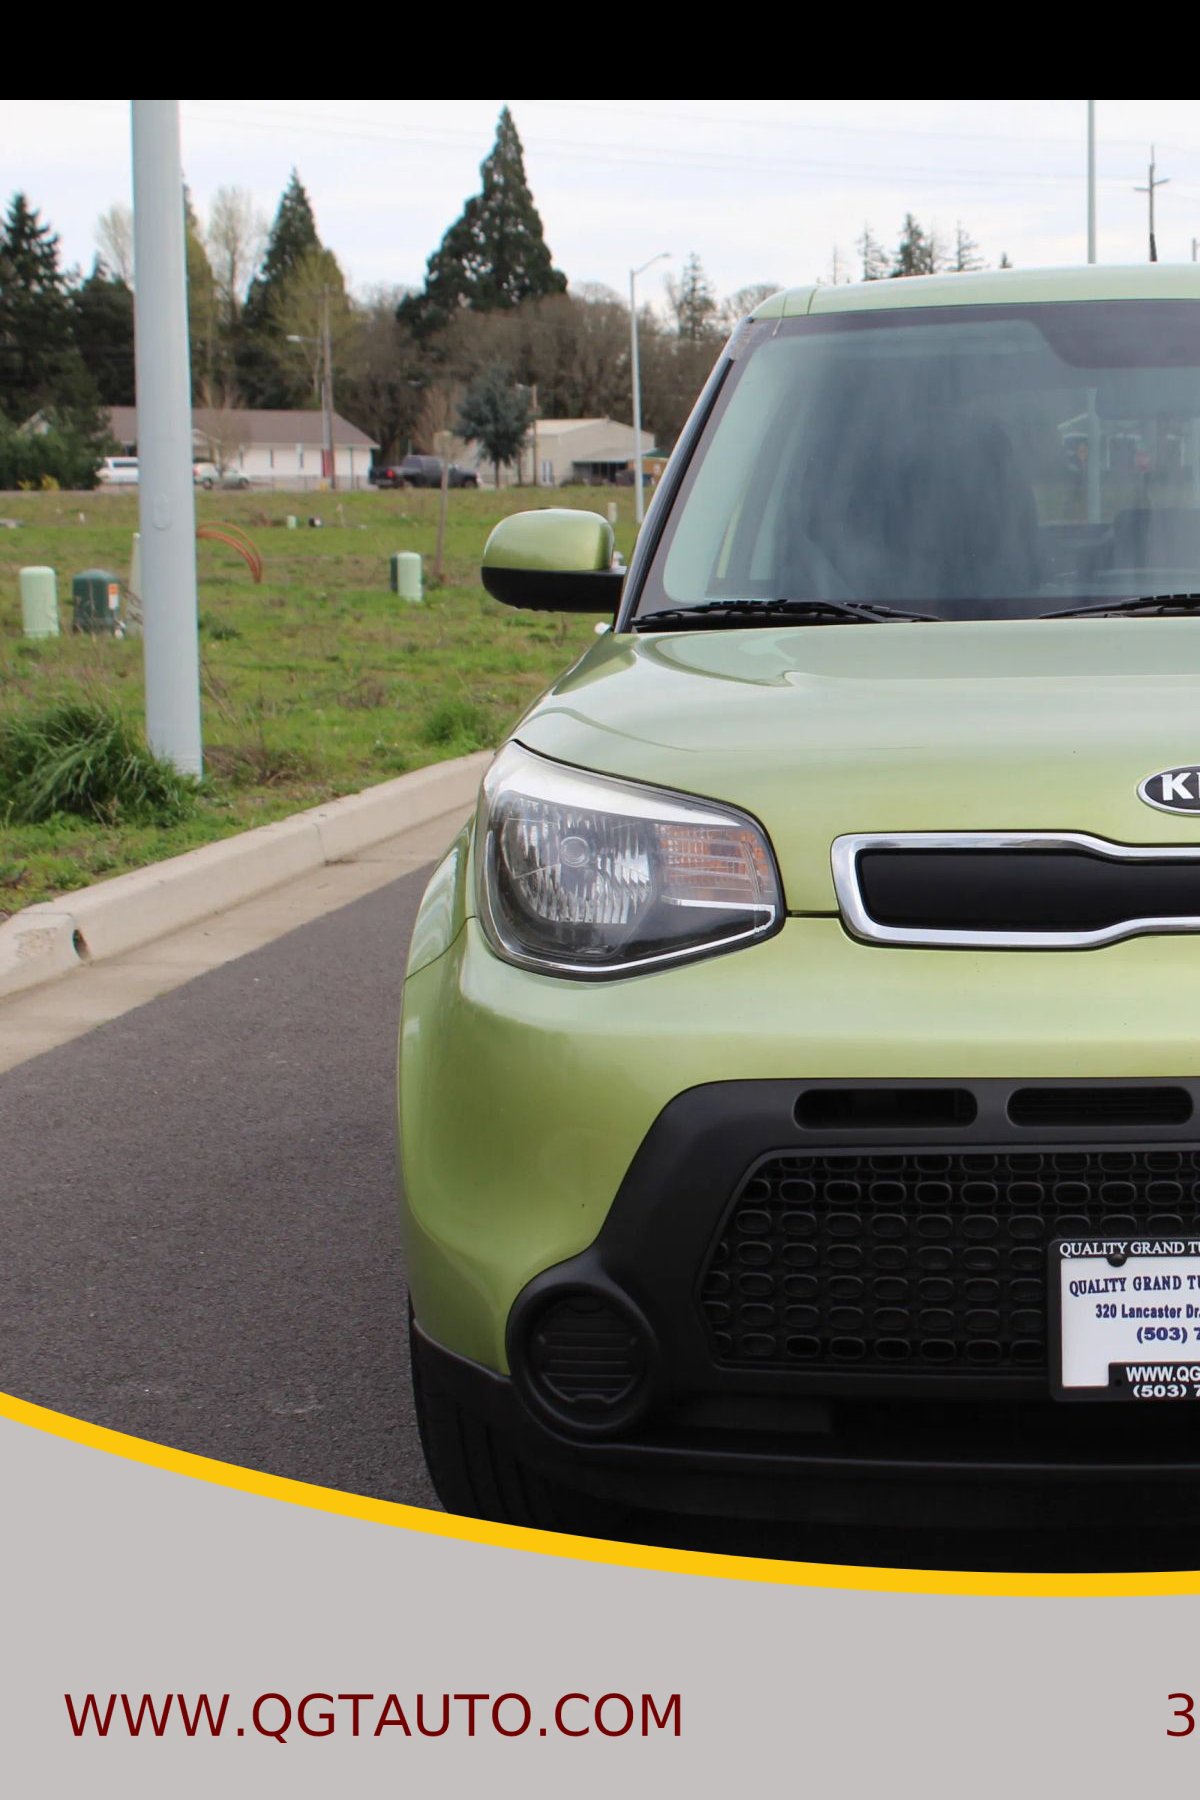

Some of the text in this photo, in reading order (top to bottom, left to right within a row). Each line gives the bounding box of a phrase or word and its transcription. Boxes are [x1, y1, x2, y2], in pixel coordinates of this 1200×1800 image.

[1060, 1242, 1128, 1257] QUALITY
[1130, 1241, 1185, 1254] GRAND
[1069, 1277, 1127, 1297] QUALITY
[1133, 1276, 1182, 1291] GRAND
[1095, 1303, 1117, 1318] 320
[1121, 1304, 1182, 1318] Lancaster
[1136, 1327, 1188, 1344] (503)
[1132, 1384, 1187, 1398] (503)
